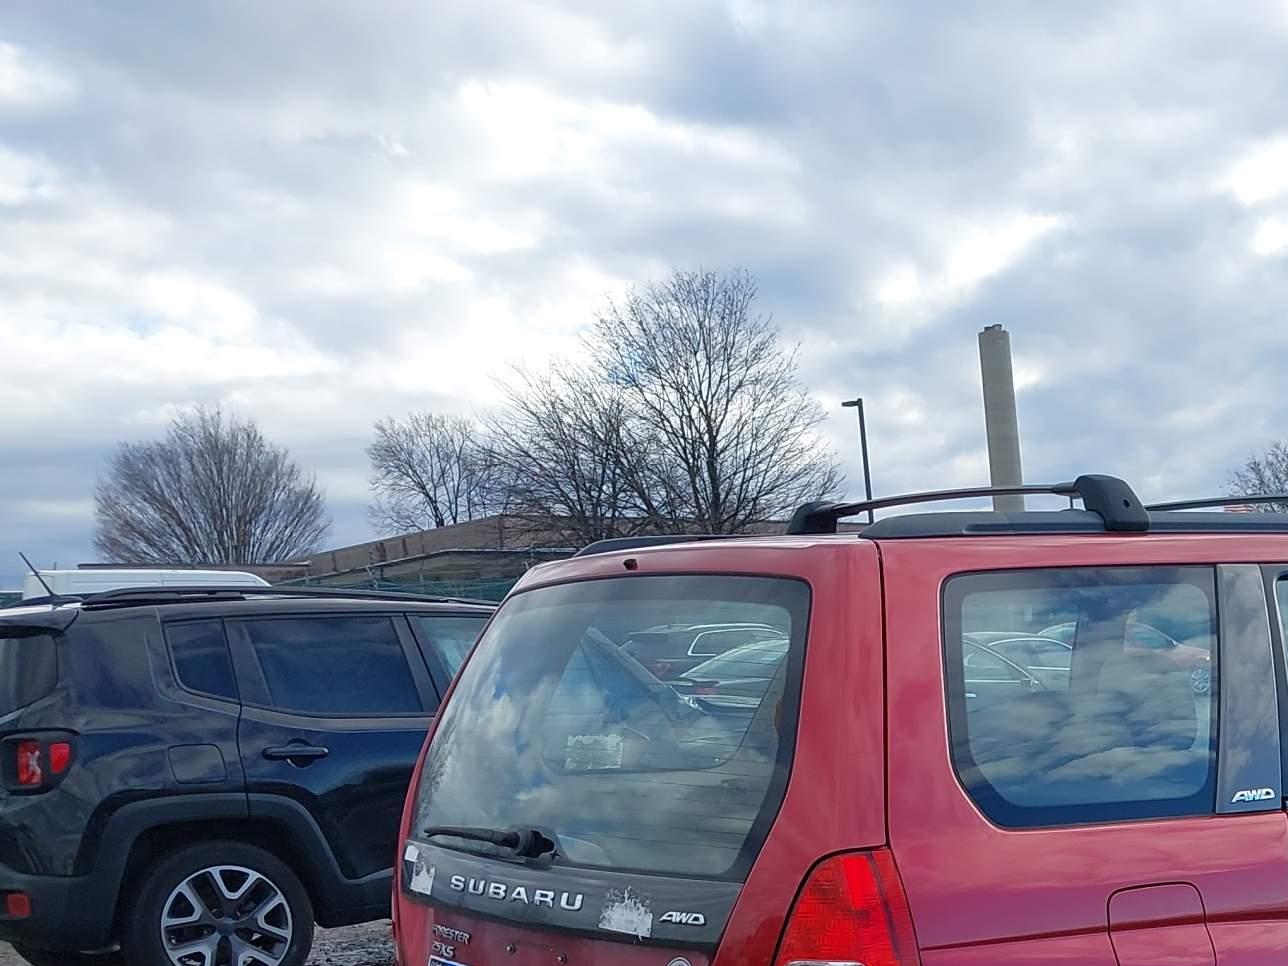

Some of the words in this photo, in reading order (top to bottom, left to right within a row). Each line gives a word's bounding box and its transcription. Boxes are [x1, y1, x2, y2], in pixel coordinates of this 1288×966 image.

[1231, 788, 1276, 803] AWD
[449, 874, 585, 912] SUBARU
[658, 910, 707, 925] AWD
[431, 924, 471, 945] FORESTER
